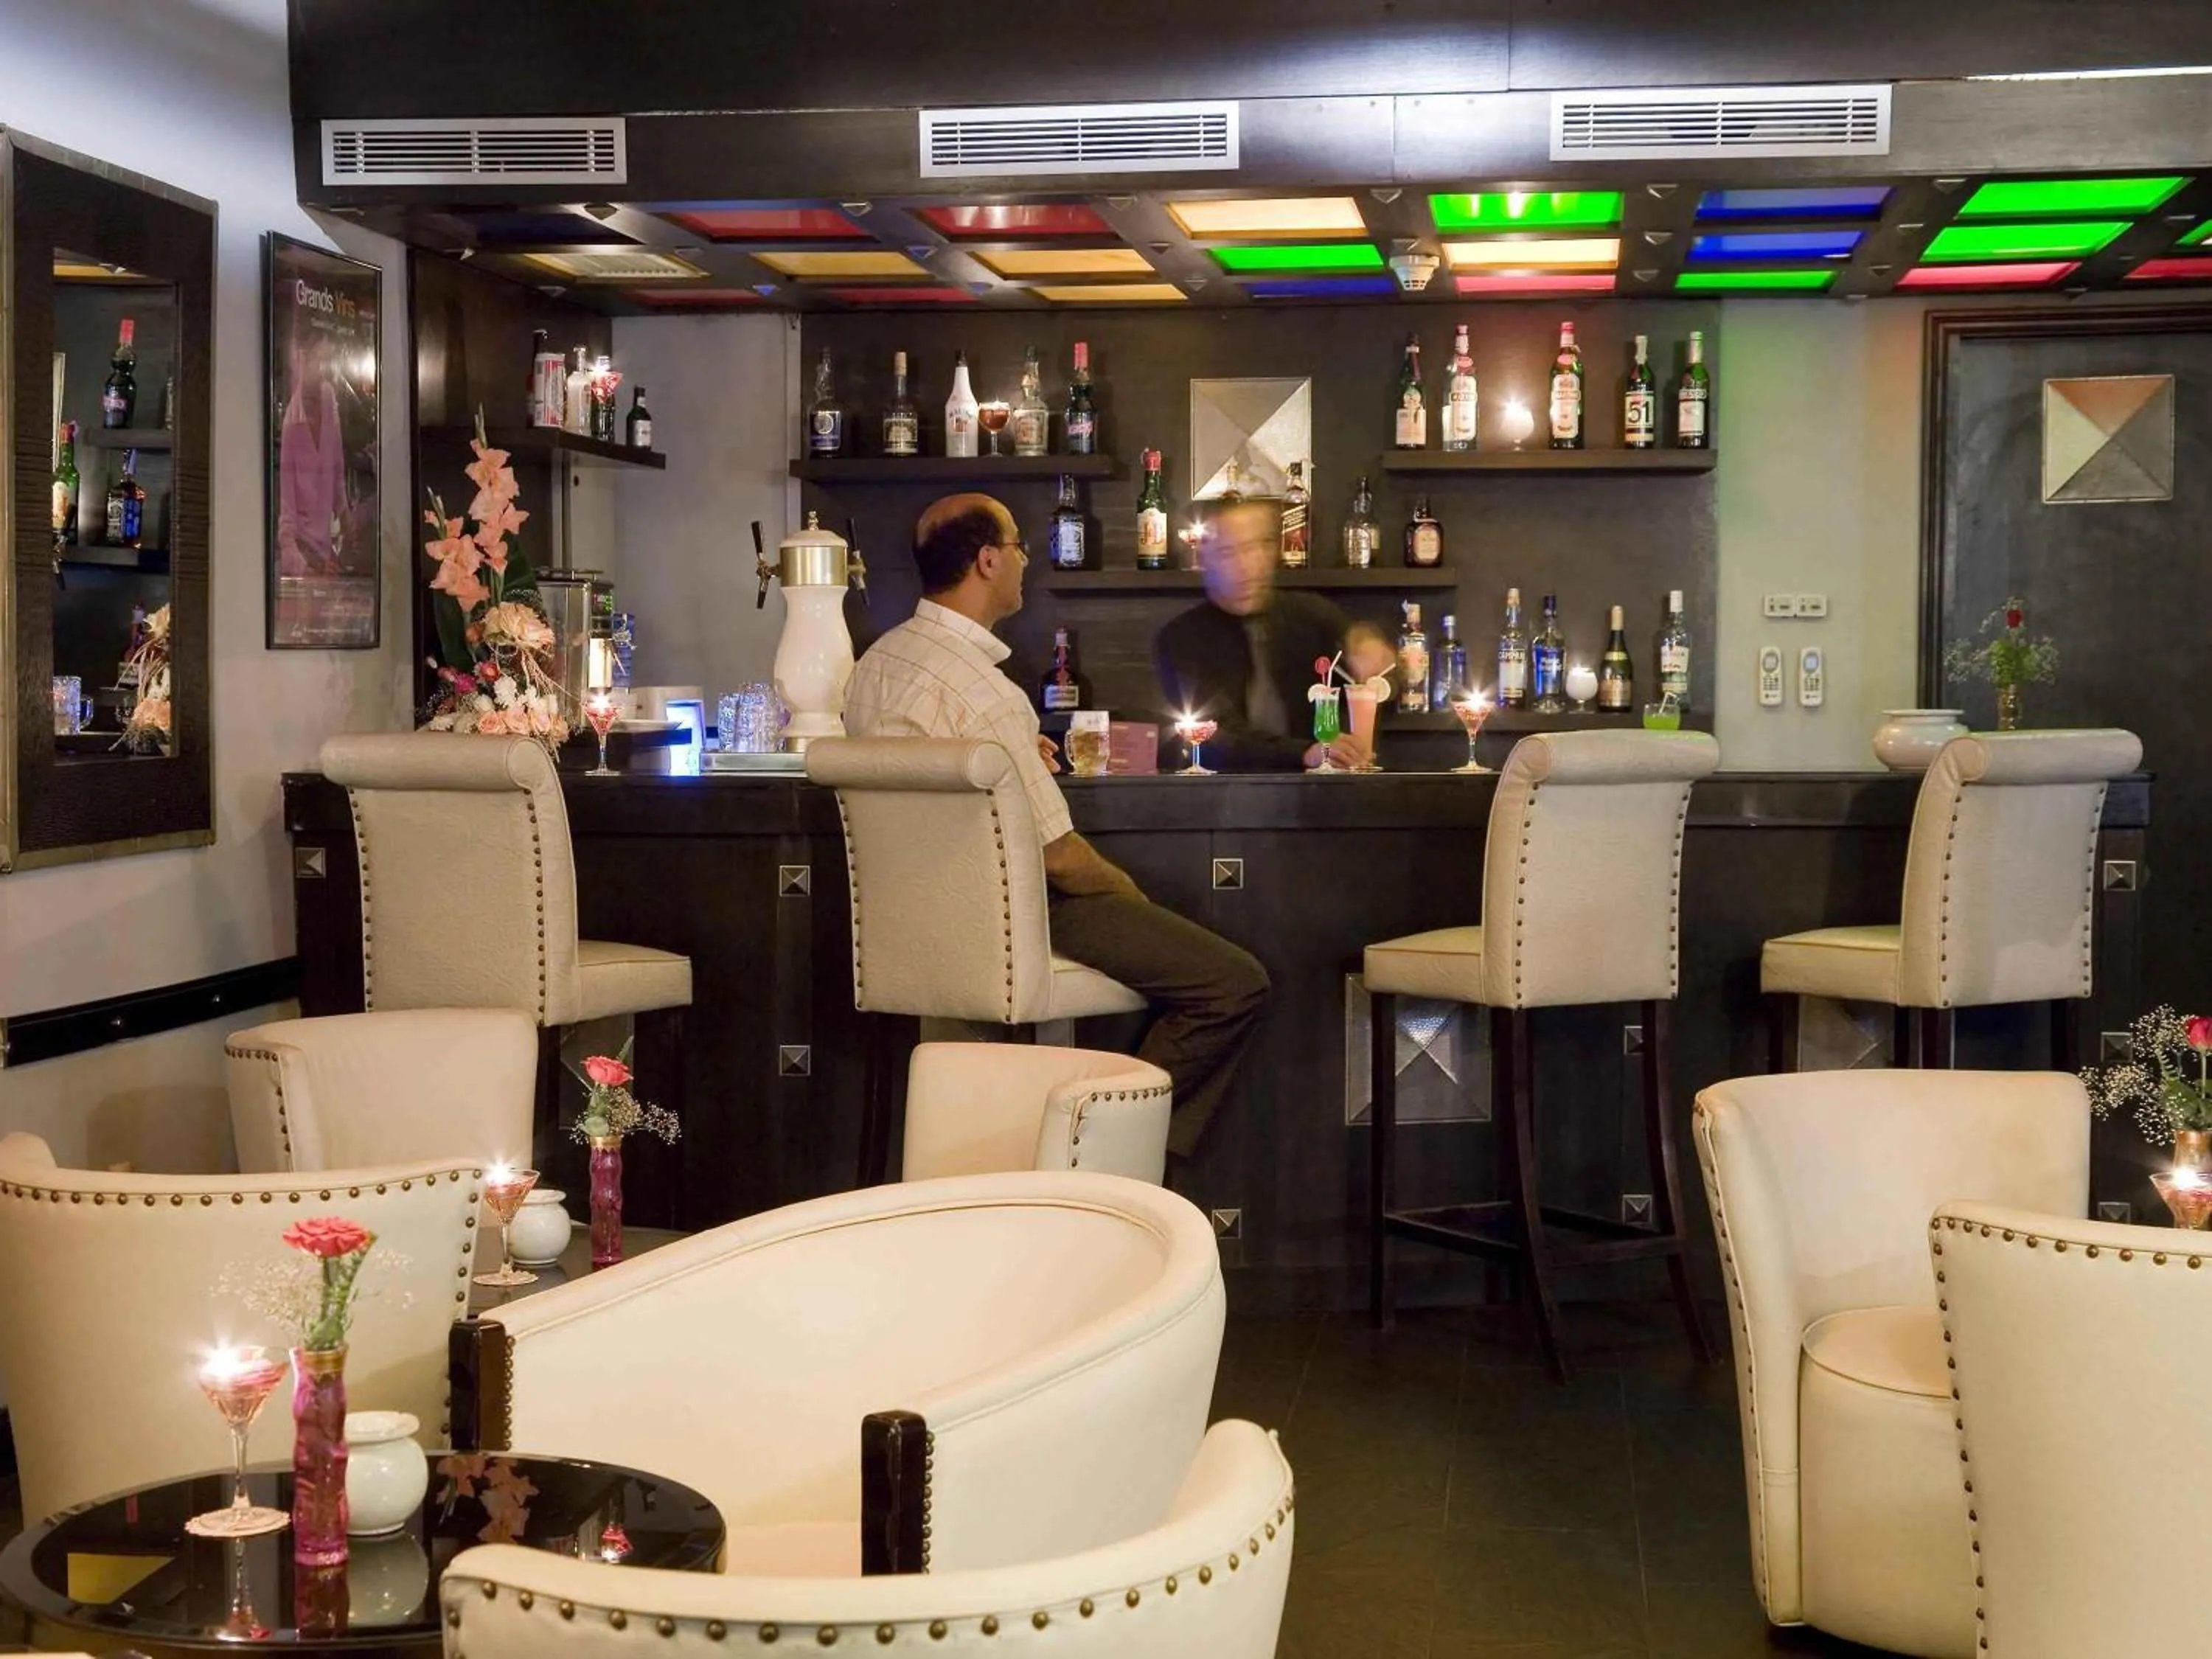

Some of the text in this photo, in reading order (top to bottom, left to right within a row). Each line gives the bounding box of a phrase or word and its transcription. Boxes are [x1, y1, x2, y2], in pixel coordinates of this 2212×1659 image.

[296, 279, 355, 319] Grands Vins
[1627, 400, 1649, 423] 51
